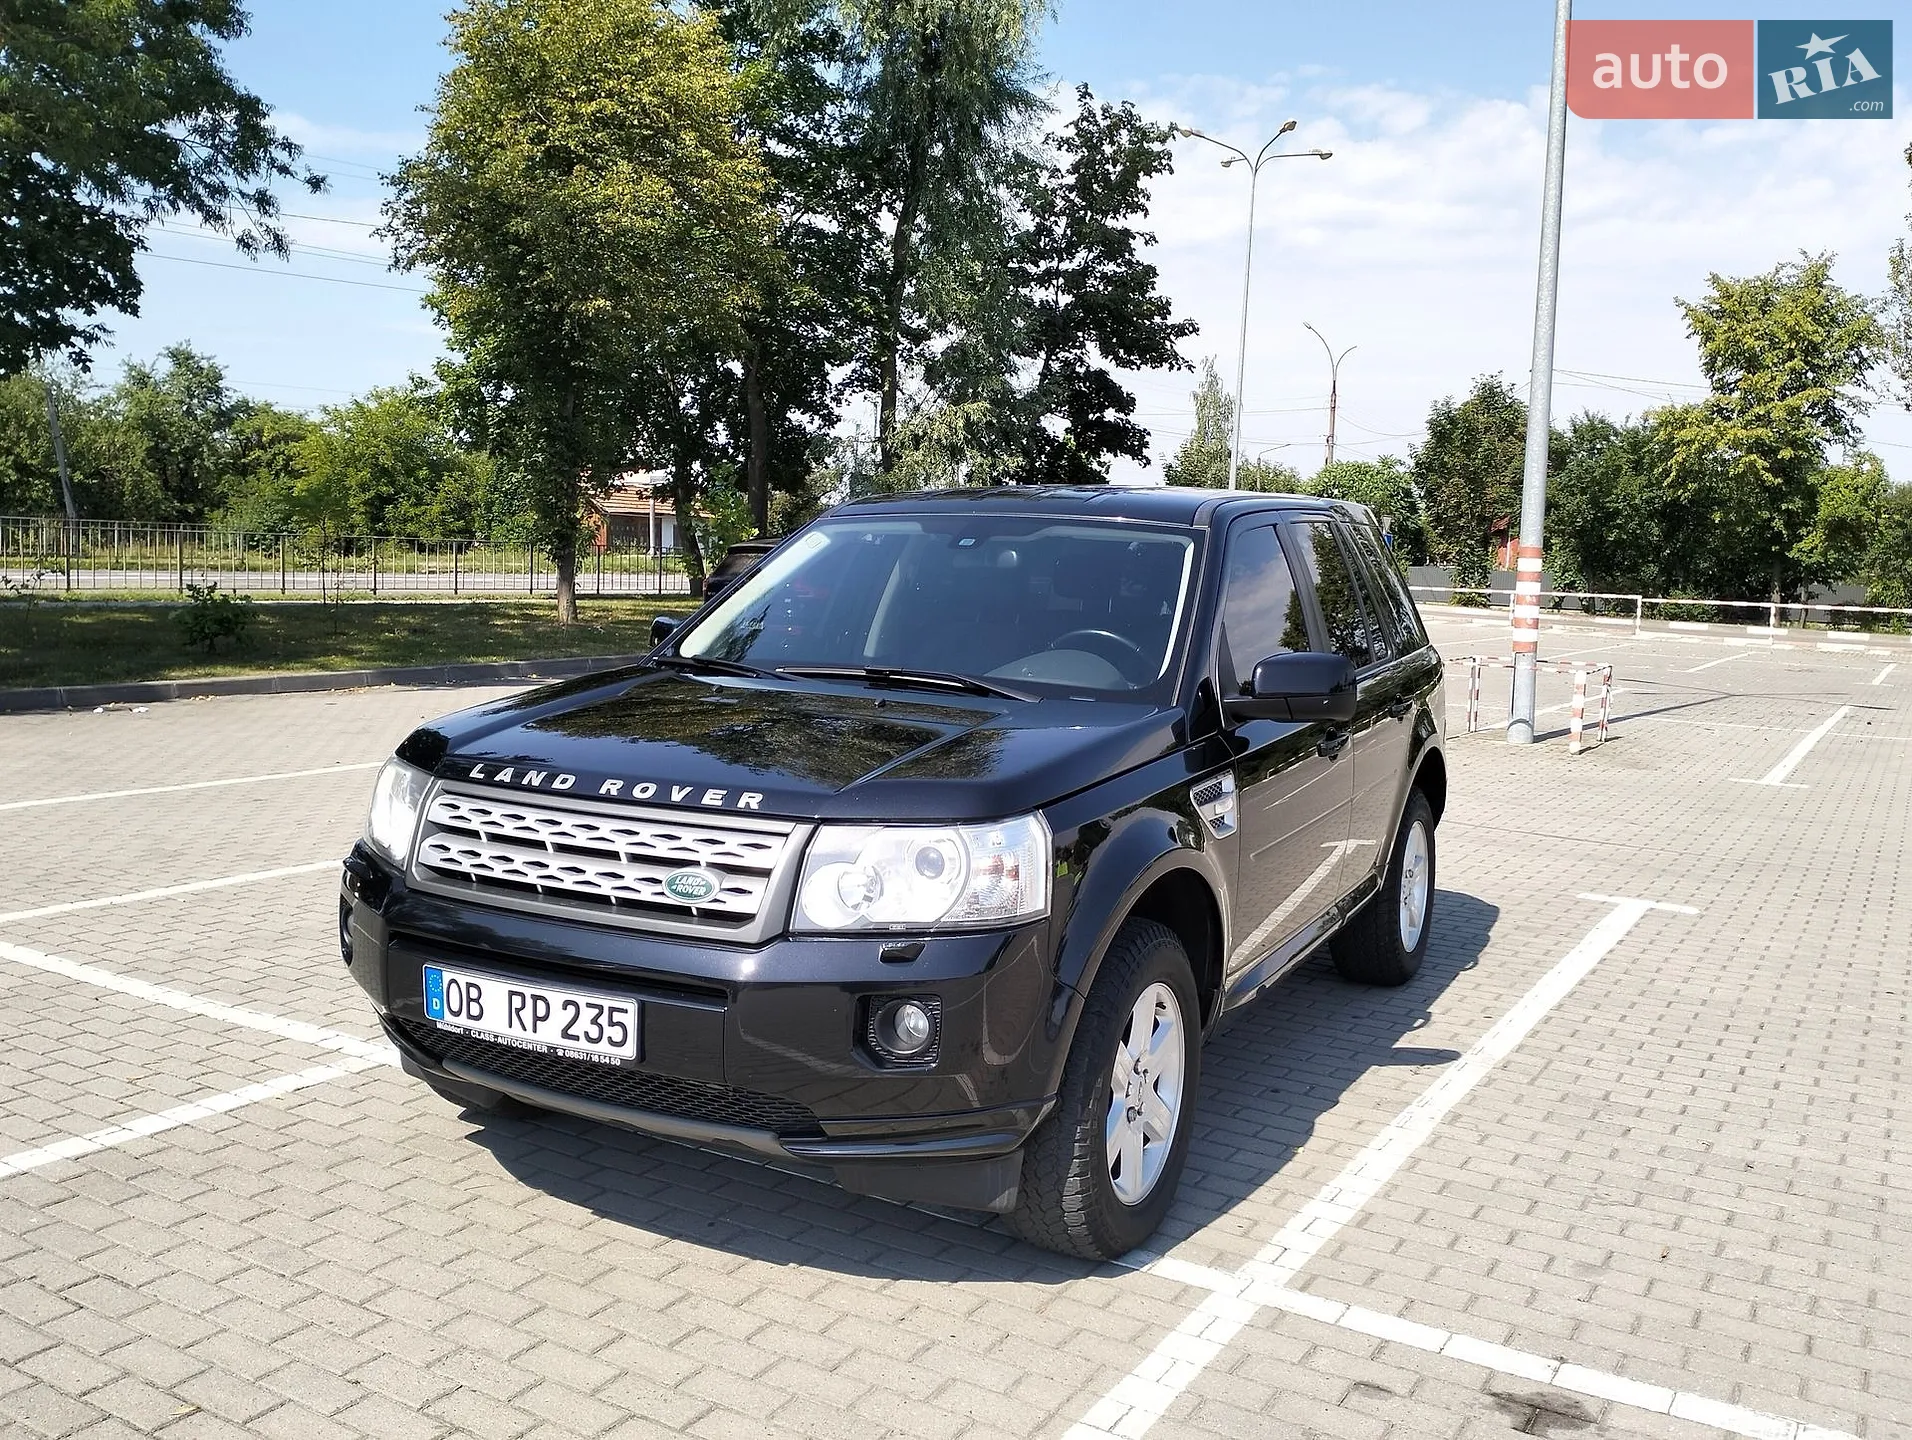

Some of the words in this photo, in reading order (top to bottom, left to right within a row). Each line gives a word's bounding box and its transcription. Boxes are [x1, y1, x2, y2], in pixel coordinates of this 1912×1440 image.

[469, 763, 576, 790] LAND
[599, 779, 764, 810] ROVER
[675, 875, 701, 886] LAND
[675, 884, 706, 896] ROVER
[432, 997, 440, 1010] D
[446, 978, 484, 1022] OB
[507, 989, 551, 1034] RP
[561, 999, 629, 1048] 235
